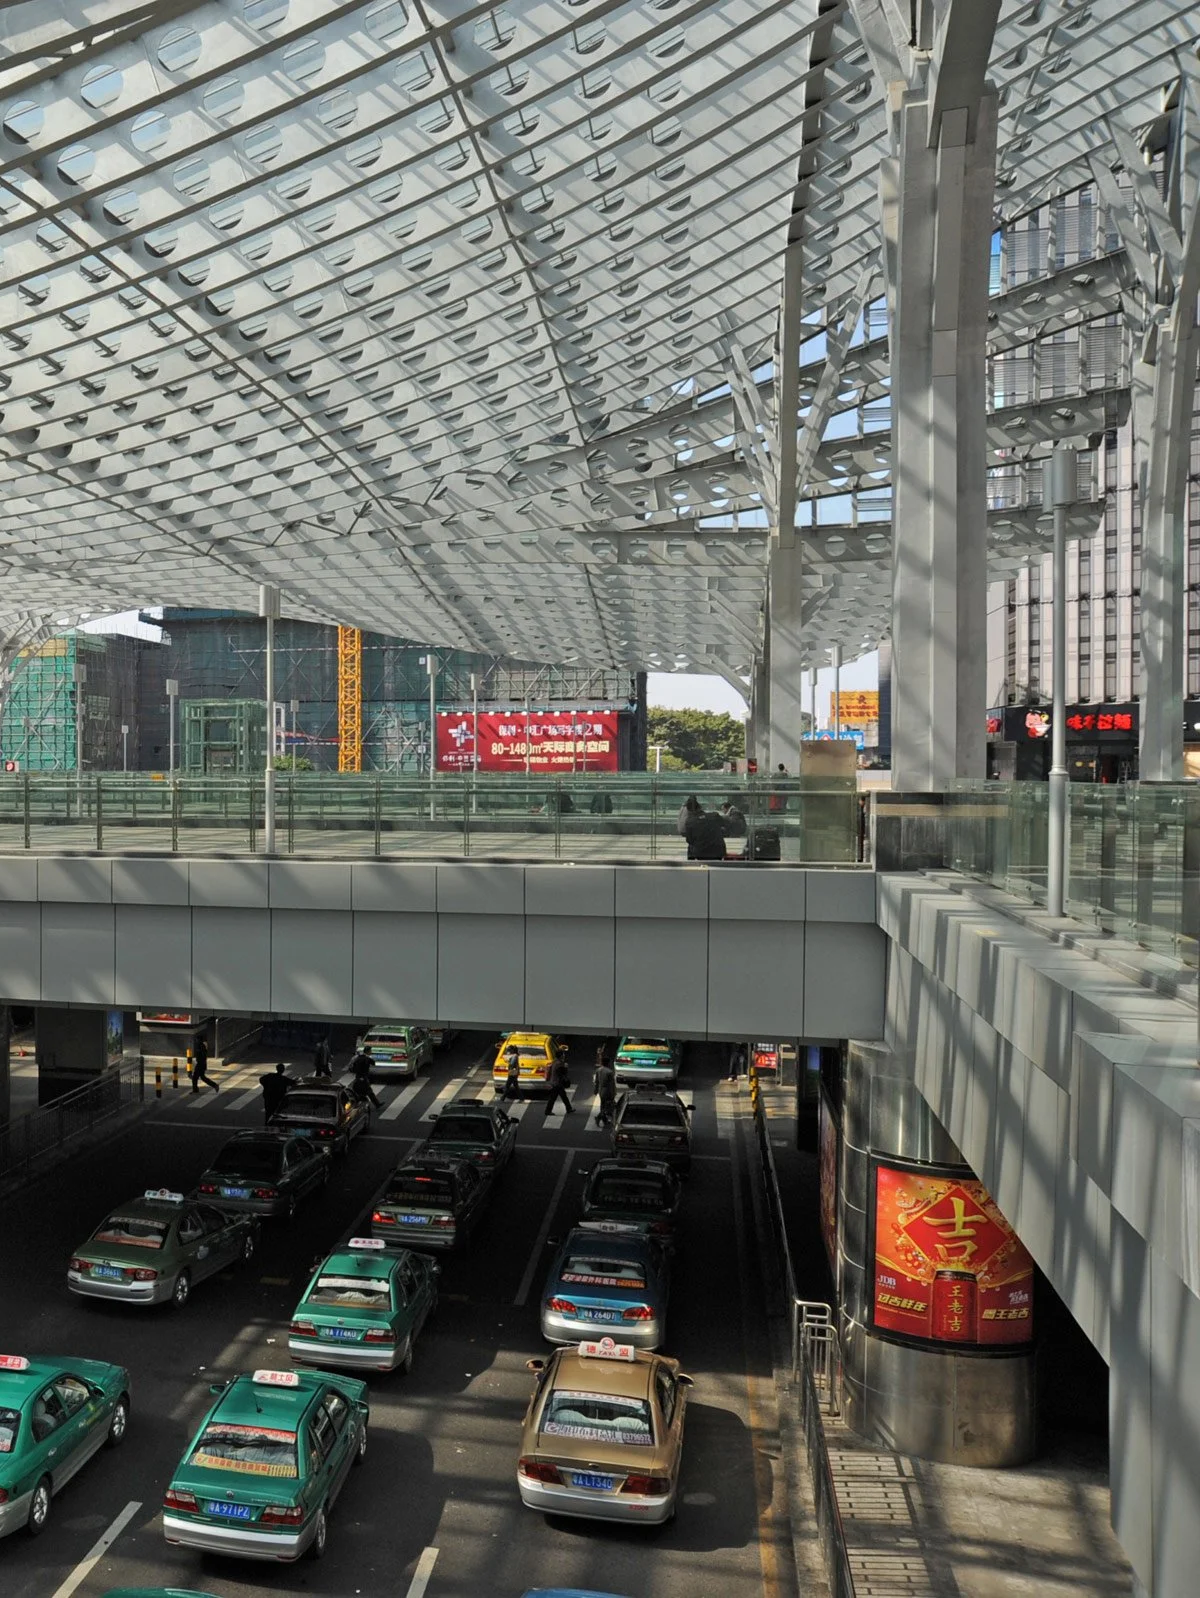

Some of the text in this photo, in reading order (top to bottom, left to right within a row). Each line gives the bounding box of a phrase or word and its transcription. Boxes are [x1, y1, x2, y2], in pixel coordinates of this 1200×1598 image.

[922, 1196, 988, 1261] 吉
[877, 1275, 897, 1286] JDB
[948, 1285, 964, 1332] 王老吉
[981, 1307, 1030, 1320] 喝王老吉
